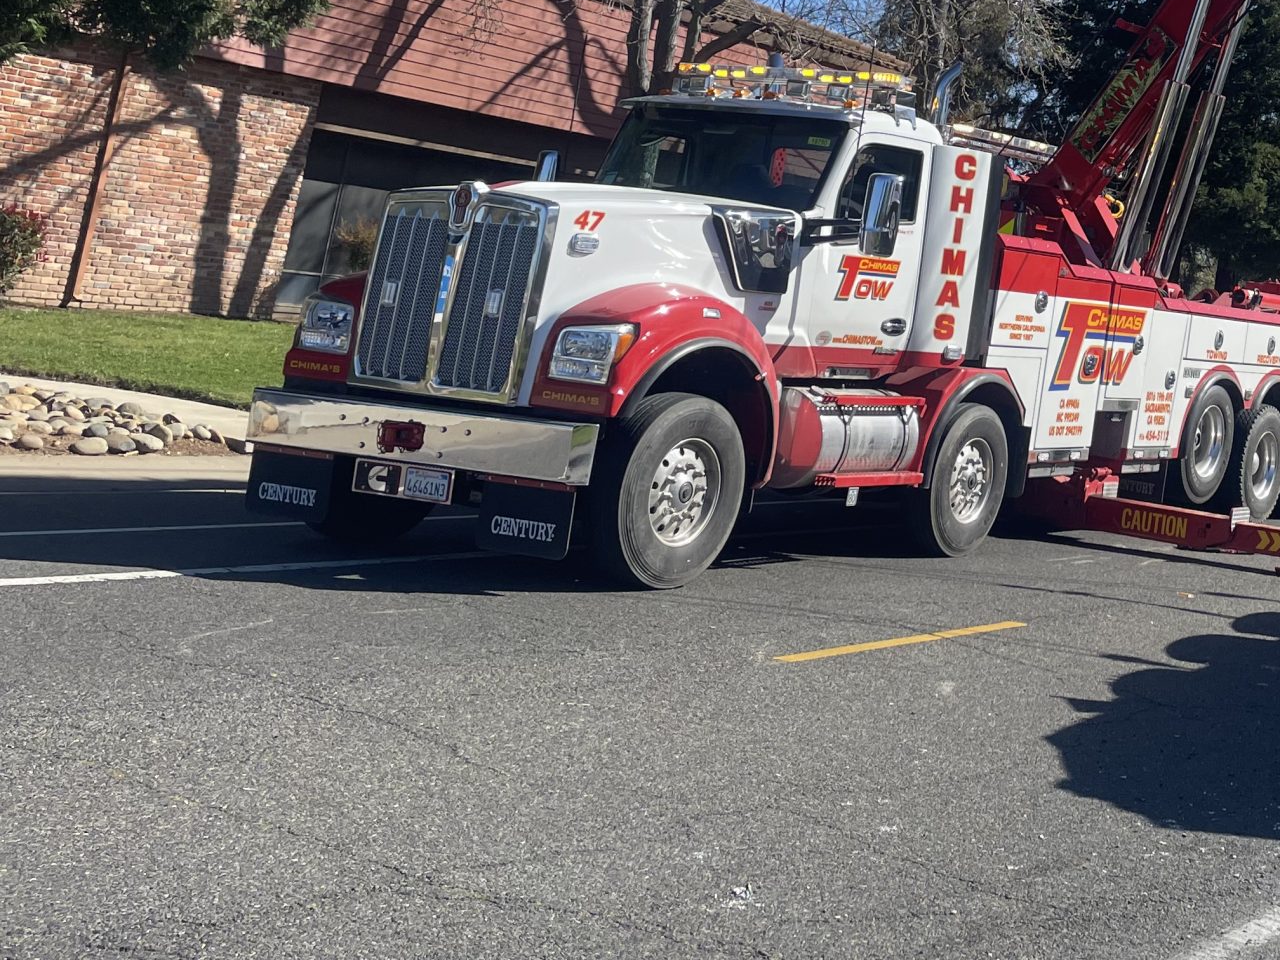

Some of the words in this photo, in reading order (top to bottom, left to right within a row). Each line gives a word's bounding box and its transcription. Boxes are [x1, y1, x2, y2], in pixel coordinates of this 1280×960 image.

[574, 210, 606, 232] 47
[834, 255, 900, 301] TOW
[1087, 309, 1143, 331] CHIMA'S
[1048, 301, 1140, 391] TOW
[1206, 350, 1228, 360] TOWING
[289, 360, 341, 373] CHIMA'S
[542, 391, 600, 406] CHIMA'S
[258, 482, 316, 507] CENTURY
[491, 515, 556, 542] CENTURY
[1121, 508, 1188, 538] CAUTION
